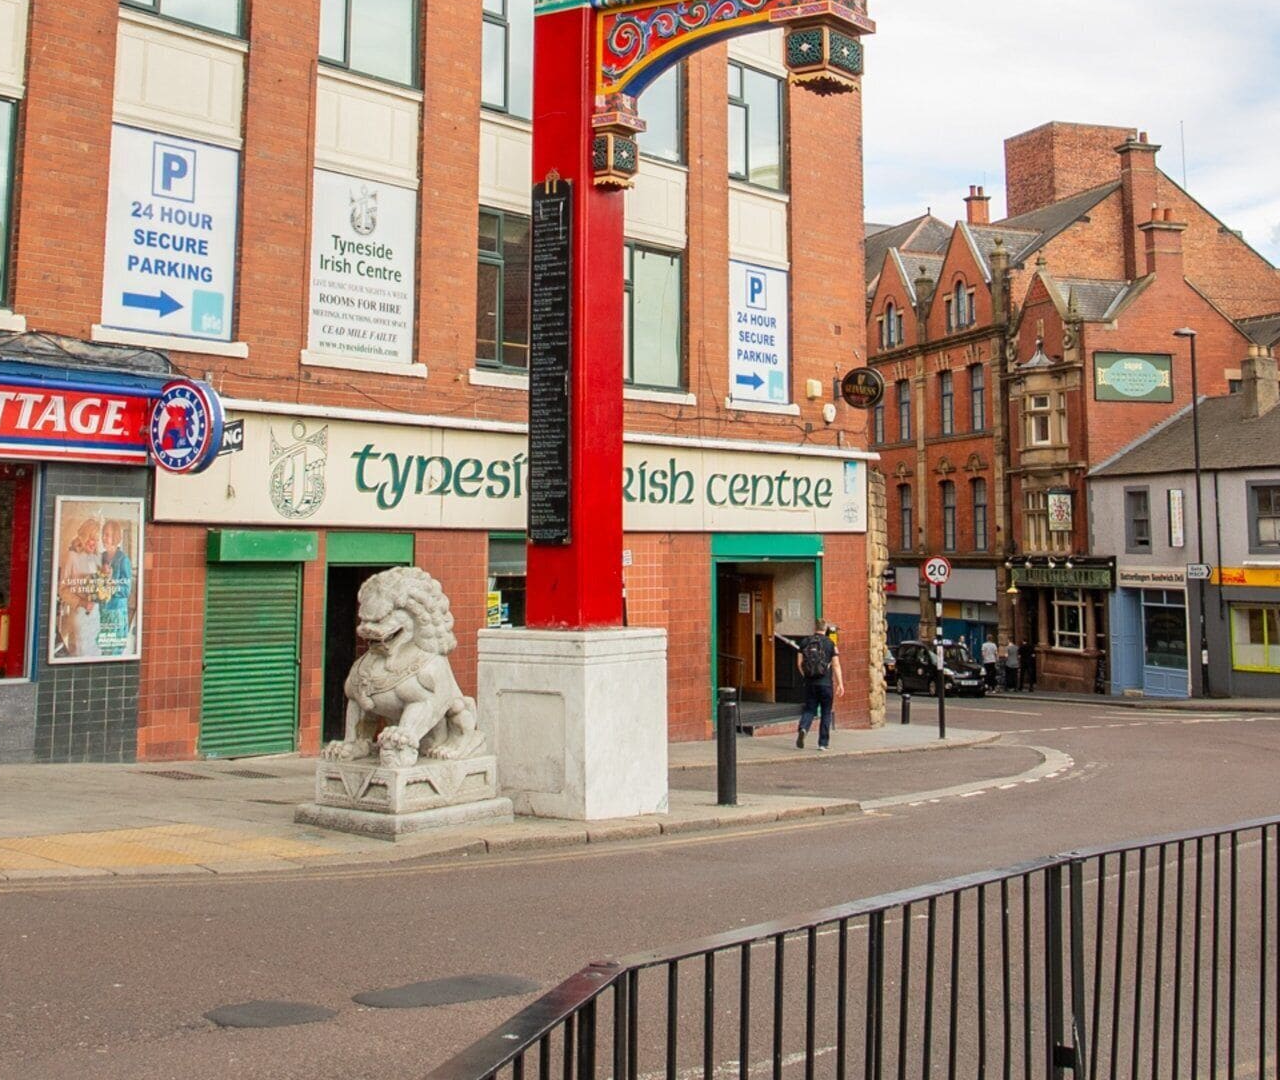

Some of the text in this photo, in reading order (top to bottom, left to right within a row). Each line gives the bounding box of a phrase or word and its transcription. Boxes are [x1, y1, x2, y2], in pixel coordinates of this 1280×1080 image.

[161, 151, 188, 192] P
[131, 201, 213, 231] 24 HOUR
[133, 228, 209, 256] SECURE
[331, 234, 394, 261] Tyneside
[127, 255, 213, 284] PARKING
[320, 253, 403, 284] Irish Centre
[312, 278, 326, 287] LIVE
[328, 280, 347, 290] MUSIC
[750, 276, 762, 304] P
[319, 292, 403, 315] ROOMS FOR HIRE
[737, 311, 777, 329] 24 HOUR
[322, 324, 399, 343] CEAD MILE FAILTE
[738, 330, 776, 347] SECURE
[319, 341, 399, 357] www.tynesideirish.com
[736, 348, 778, 365] PARKING
[350, 443, 528, 511] tynesi
[622, 458, 695, 505] rish
[706, 469, 834, 509] centre
[926, 563, 948, 577] 20
[1151, 573, 1173, 581] Sandwich
[1174, 573, 1184, 582] Deli
